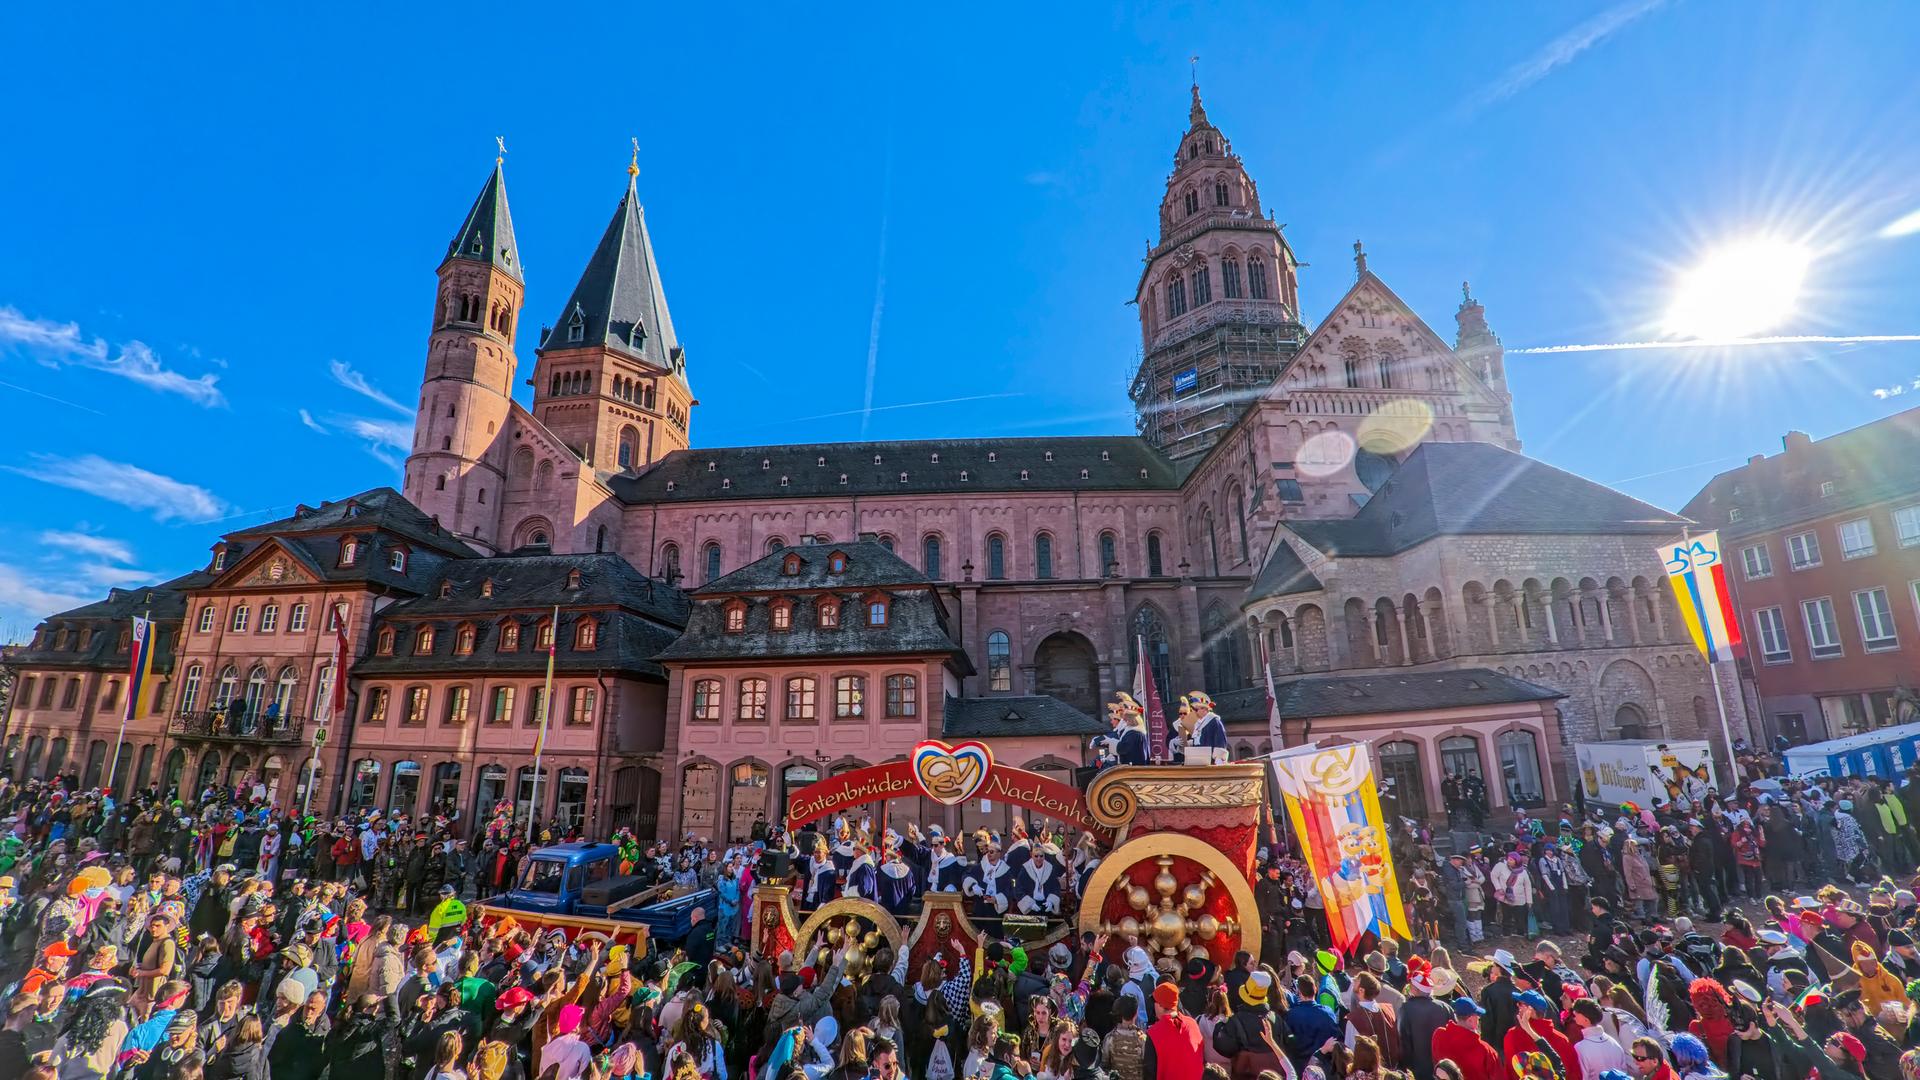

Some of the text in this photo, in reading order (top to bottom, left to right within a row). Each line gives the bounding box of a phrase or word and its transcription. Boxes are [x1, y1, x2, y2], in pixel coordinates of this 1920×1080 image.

[316, 728, 326, 741] 40
[1151, 710, 1164, 759] OHER
[789, 771, 912, 820] Entenbrüder
[1600, 762, 1646, 793] Bitburger
